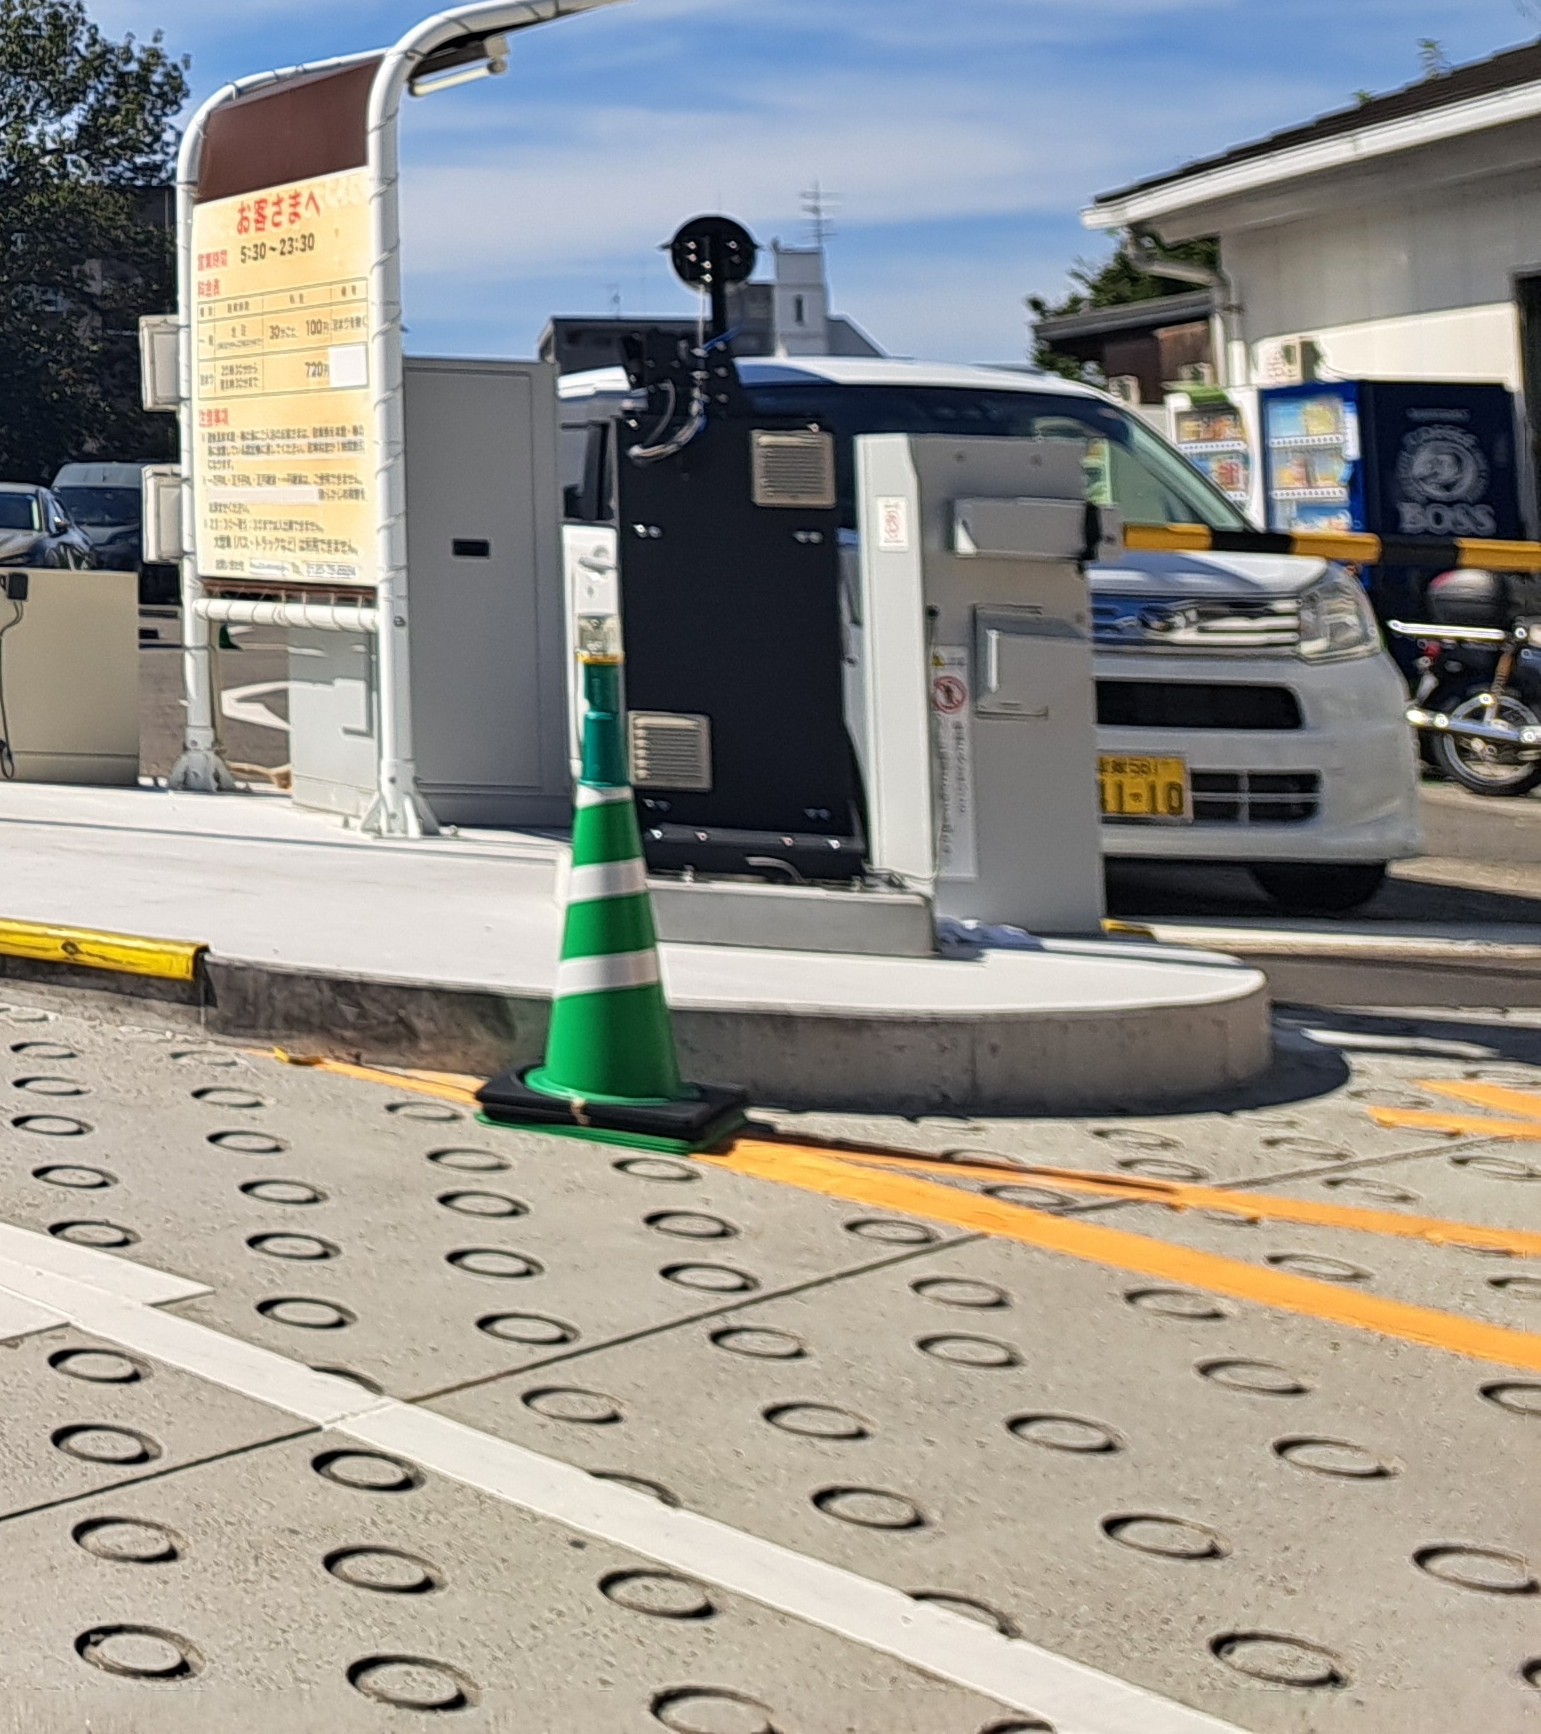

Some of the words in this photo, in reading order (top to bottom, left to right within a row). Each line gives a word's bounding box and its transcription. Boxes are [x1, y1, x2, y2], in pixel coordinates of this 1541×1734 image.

[236, 189, 321, 235] お客さまへ
[1398, 501, 1497, 536] BOSS
